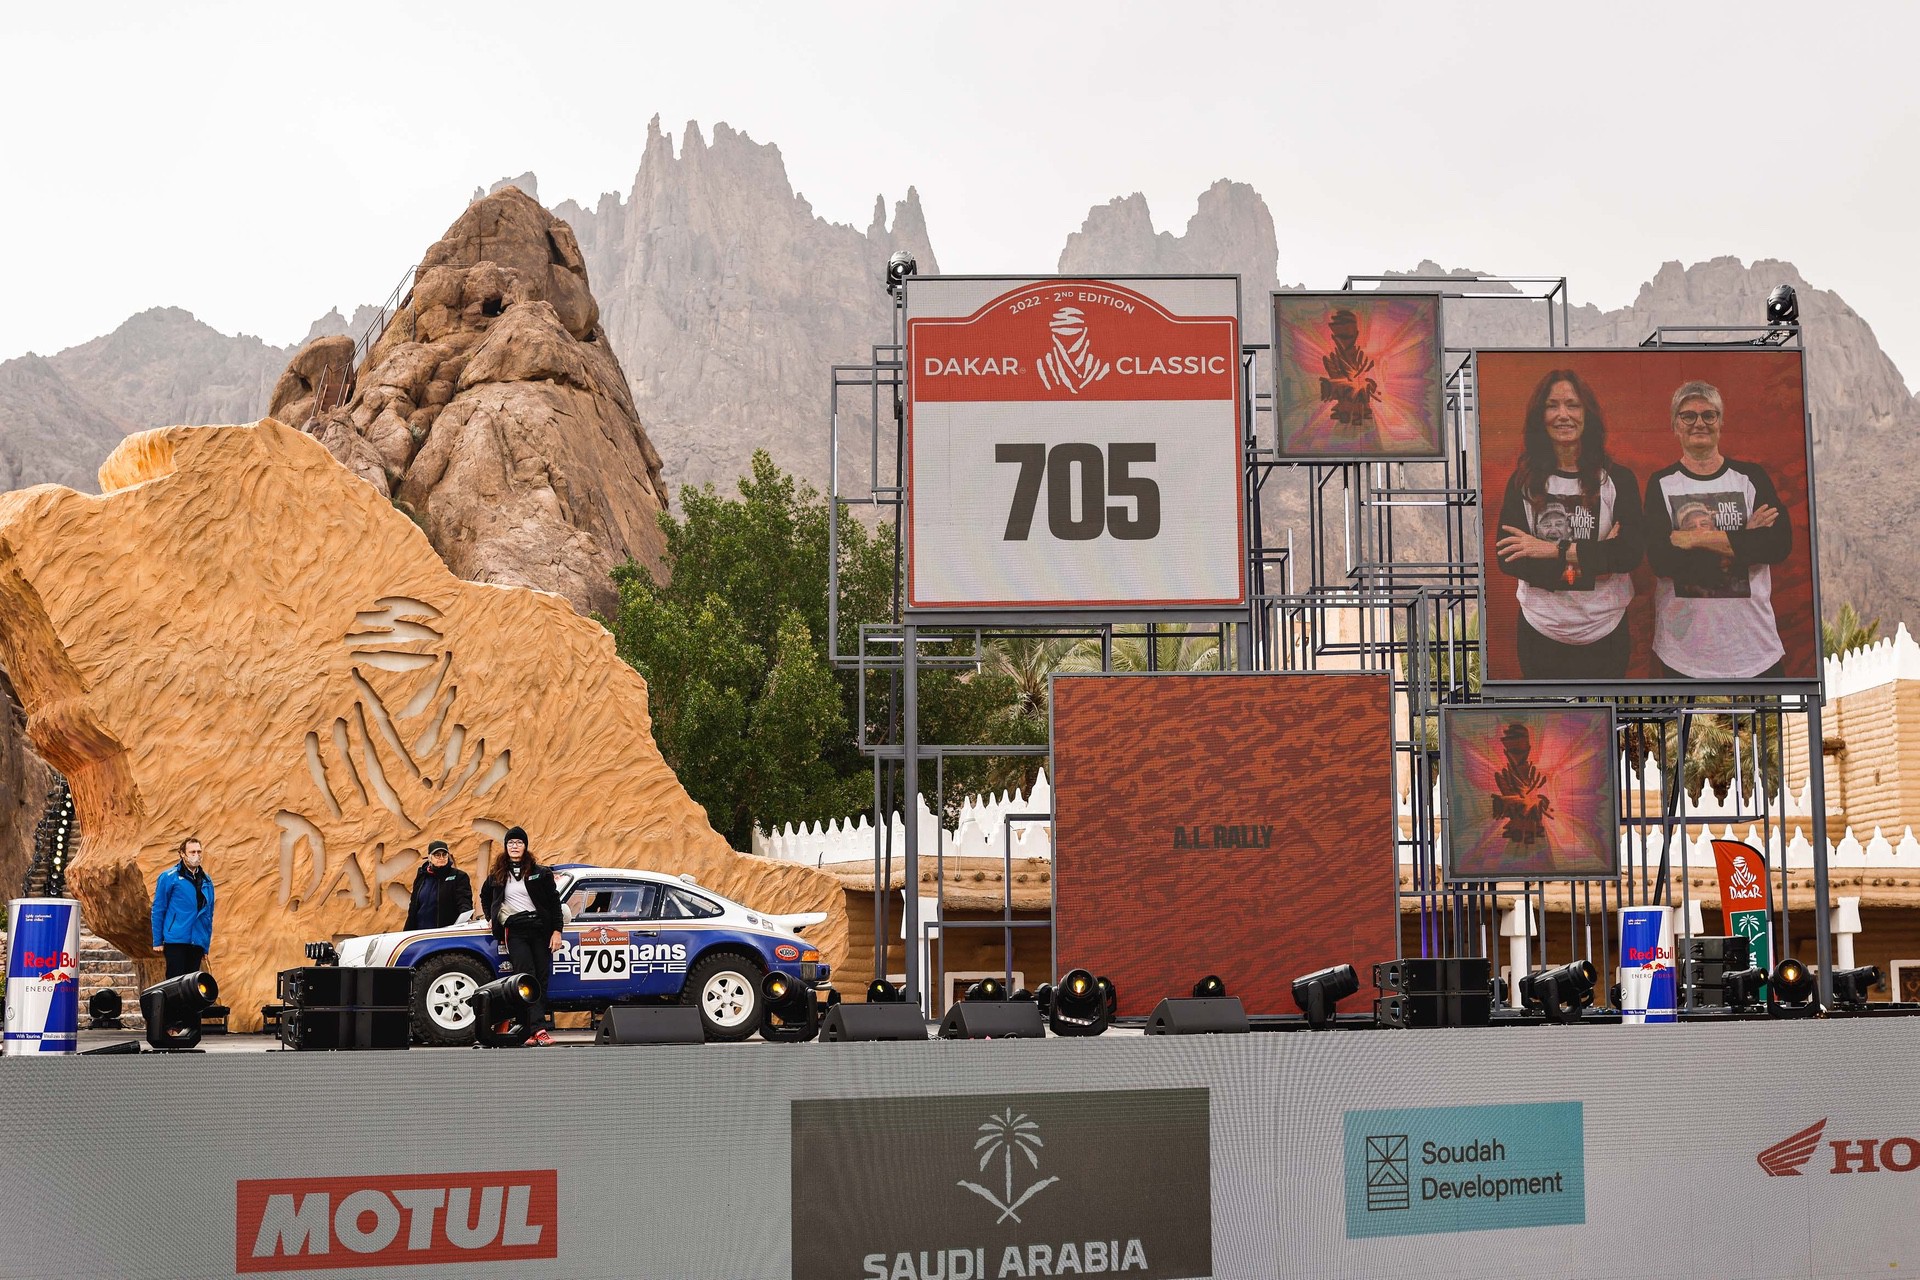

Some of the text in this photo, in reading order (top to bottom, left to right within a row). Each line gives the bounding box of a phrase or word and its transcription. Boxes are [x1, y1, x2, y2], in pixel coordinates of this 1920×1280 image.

[1009, 296, 1041, 315] 2022
[1078, 292, 1135, 314] EDITION
[924, 355, 1225, 376] DAKAR CLASSIC
[994, 442, 1161, 541] 705
[1574, 505, 1592, 517] ONE
[1718, 501, 1738, 513] ONE
[1570, 516, 1595, 529] MORE
[1715, 512, 1743, 526] MORE
[1574, 527, 1591, 540] WIN
[1213, 824, 1274, 849] RALLY
[1729, 884, 1762, 900] DAKAR
[24, 951, 57, 968] Red
[584, 949, 627, 973] 705
[1629, 946, 1674, 960] Red Bull
[1421, 1138, 1505, 1165] Soudah
[1421, 1172, 1563, 1201] Development
[252, 1185, 543, 1258] MOTUL
[863, 1239, 1149, 1280] SAUDI ARABIA
